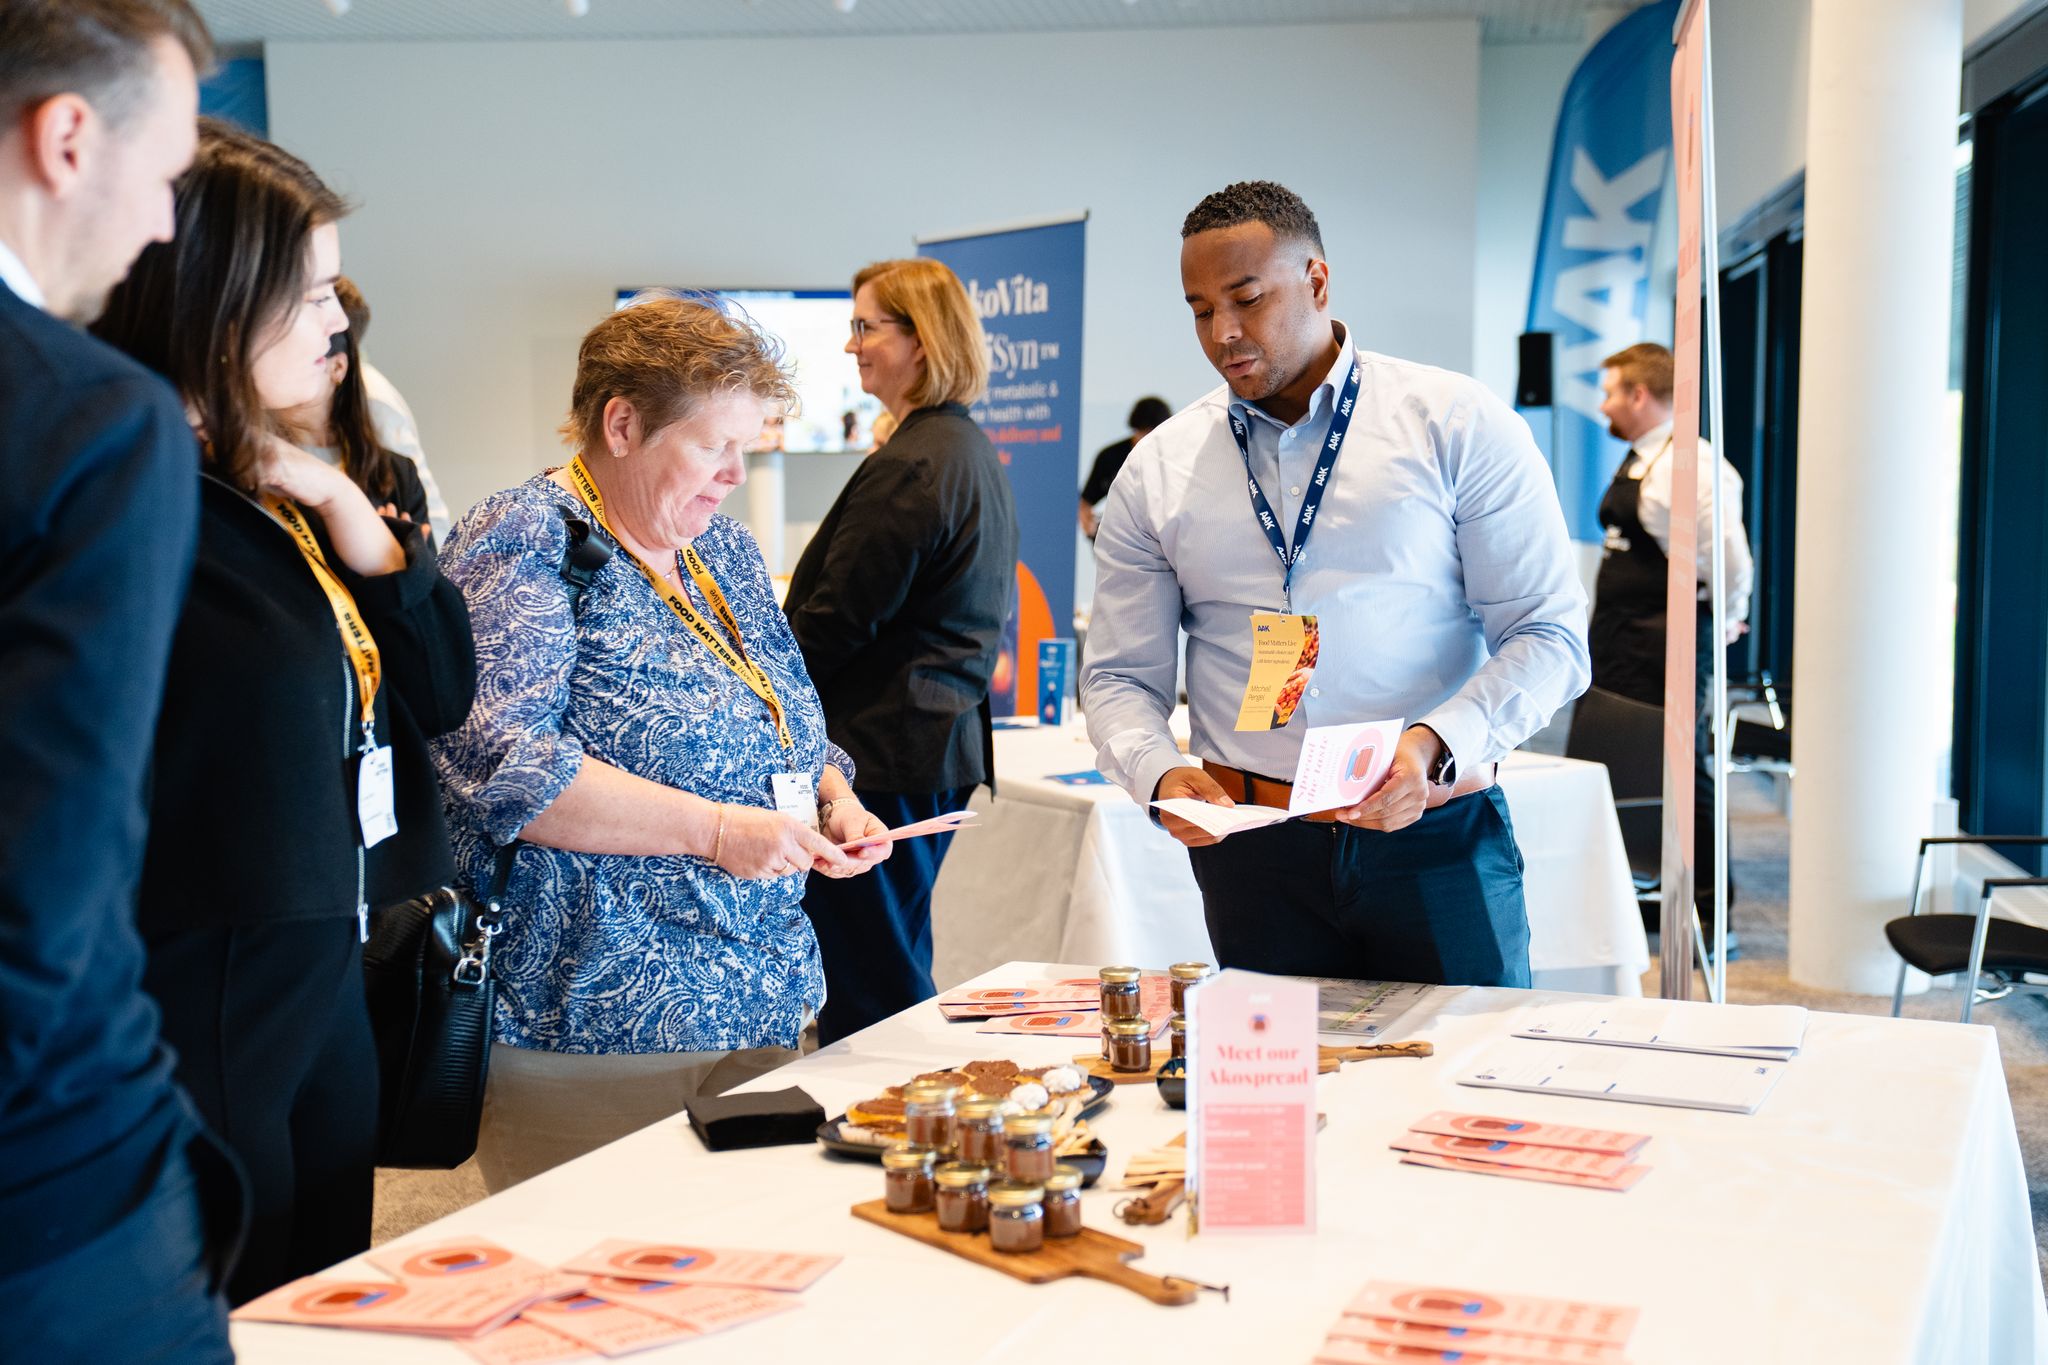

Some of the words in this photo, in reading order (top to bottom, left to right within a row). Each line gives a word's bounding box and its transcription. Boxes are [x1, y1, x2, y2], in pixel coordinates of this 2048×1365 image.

[967, 272, 1048, 319] koVita
[1350, 364, 1361, 385] AAK
[1340, 396, 1353, 417] AAK
[1327, 431, 1342, 451] AAK
[572, 461, 599, 502] MATTERS
[1314, 466, 1329, 487] AAK
[1259, 511, 1276, 530] AAK
[1301, 504, 1316, 525] AAK
[686, 548, 704, 576] FOOD
[668, 595, 695, 623] FOOD
[693, 622, 738, 667] MATTERS
[1217, 1044, 1262, 1061] Meet
[1267, 1047, 1299, 1060] our
[1210, 1066, 1308, 1089] Akospread
